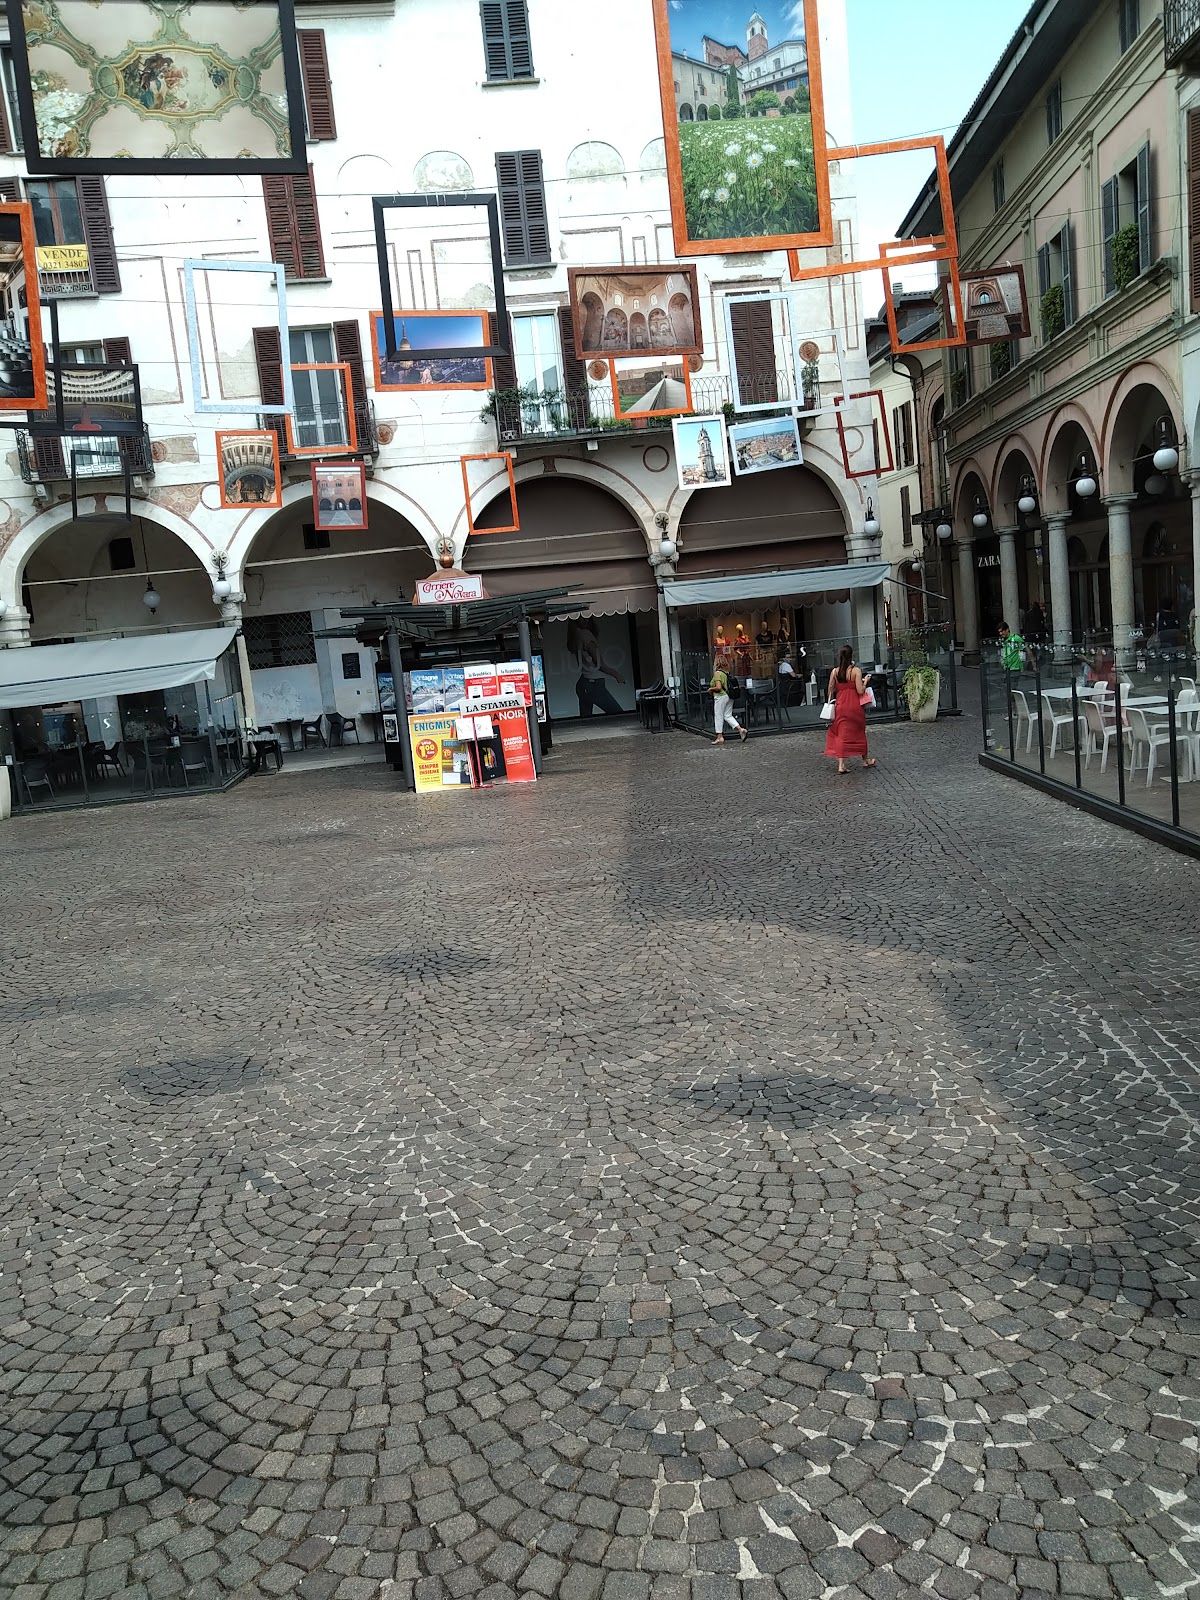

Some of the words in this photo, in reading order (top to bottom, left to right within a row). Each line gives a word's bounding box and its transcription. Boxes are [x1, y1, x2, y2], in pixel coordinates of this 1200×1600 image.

[43, 250, 83, 259] VENDE
[64, 260, 89, 268] 34807
[978, 555, 1001, 568] ZARA
[435, 585, 477, 601] Novara
[466, 705, 479, 713] LA
[481, 700, 520, 712] STAMPA
